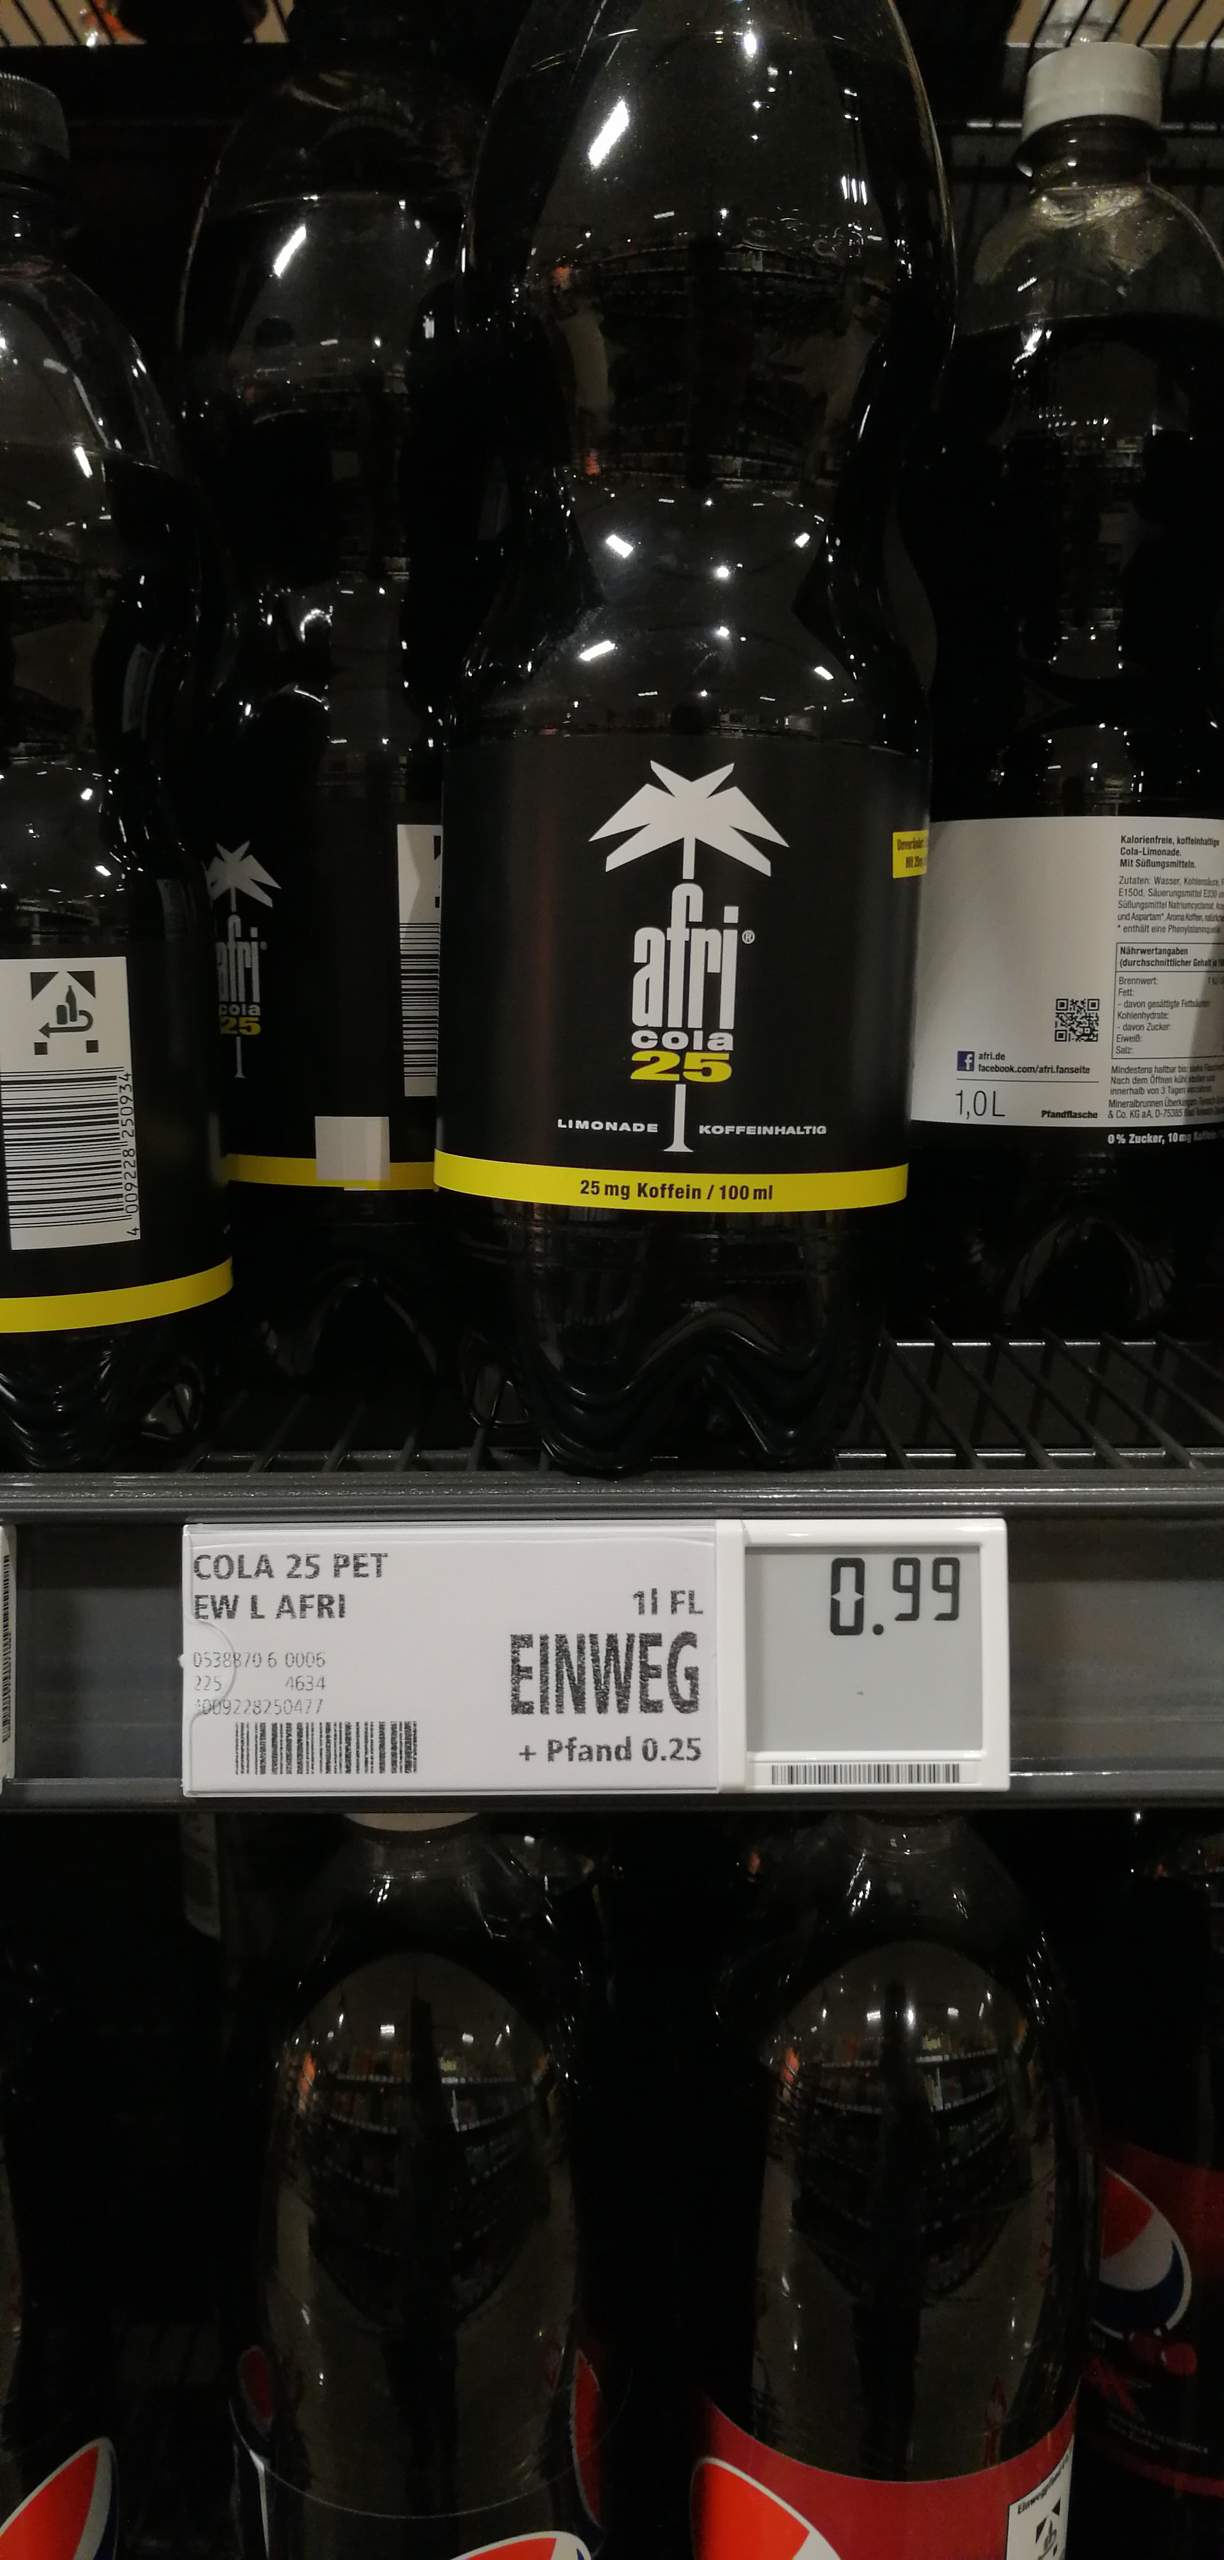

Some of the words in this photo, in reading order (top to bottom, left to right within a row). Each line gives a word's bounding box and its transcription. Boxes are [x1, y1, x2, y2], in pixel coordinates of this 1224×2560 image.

[1120, 835, 1175, 845] Kalorienfreie,
[1120, 847, 1181, 856] Cola-Limonade.
[1120, 859, 1133, 867] Mit
[1120, 946, 1188, 956] Nährwertangaben
[1120, 958, 1191, 968] (durchschnittlicher
[218, 1004, 261, 1016] cola
[220, 1016, 261, 1035] 25
[631, 1029, 734, 1051] cola
[978, 1052, 1006, 1060] afri.de
[630, 1050, 732, 1083] 25
[978, 1064, 1090, 1074] facebook.com/afri.fanseite
[119, 1072, 136, 1138] 250934
[1041, 1110, 1098, 1119] Pfandflasche
[1108, 1110, 1114, 1118] &
[557, 1119, 658, 1133] LIMONADE
[699, 1125, 827, 1135] KOFFEINHALTIG
[1116, 1134, 1126, 1144] %
[1128, 1133, 1165, 1145] Zucker,
[1168, 1132, 1178, 1143] 10
[122, 1147, 139, 1215] 009228
[580, 1180, 600, 1195] 25
[604, 1185, 630, 1199] mg
[637, 1182, 701, 1200] Koffein
[706, 1184, 714, 1200] /
[719, 1185, 749, 1200] 100
[753, 1184, 773, 1200] ml
[193, 1554, 274, 1580] COLA
[286, 1553, 320, 1579] 25
[333, 1553, 389, 1578] PET
[670, 1590, 704, 1615] FL
[830, 1557, 960, 1636] 0.99
[194, 1594, 240, 1619] EW
[250, 1594, 265, 1619] L
[275, 1594, 346, 1619] AFRI
[268, 1652, 277, 1668] 6
[285, 1652, 326, 1668] 0006
[510, 1631, 700, 1715] EINWEG
[285, 1675, 326, 1691] 4634
[518, 1744, 536, 1761] +
[547, 1736, 632, 1761] Pfand
[642, 1737, 702, 1762] 0.25
